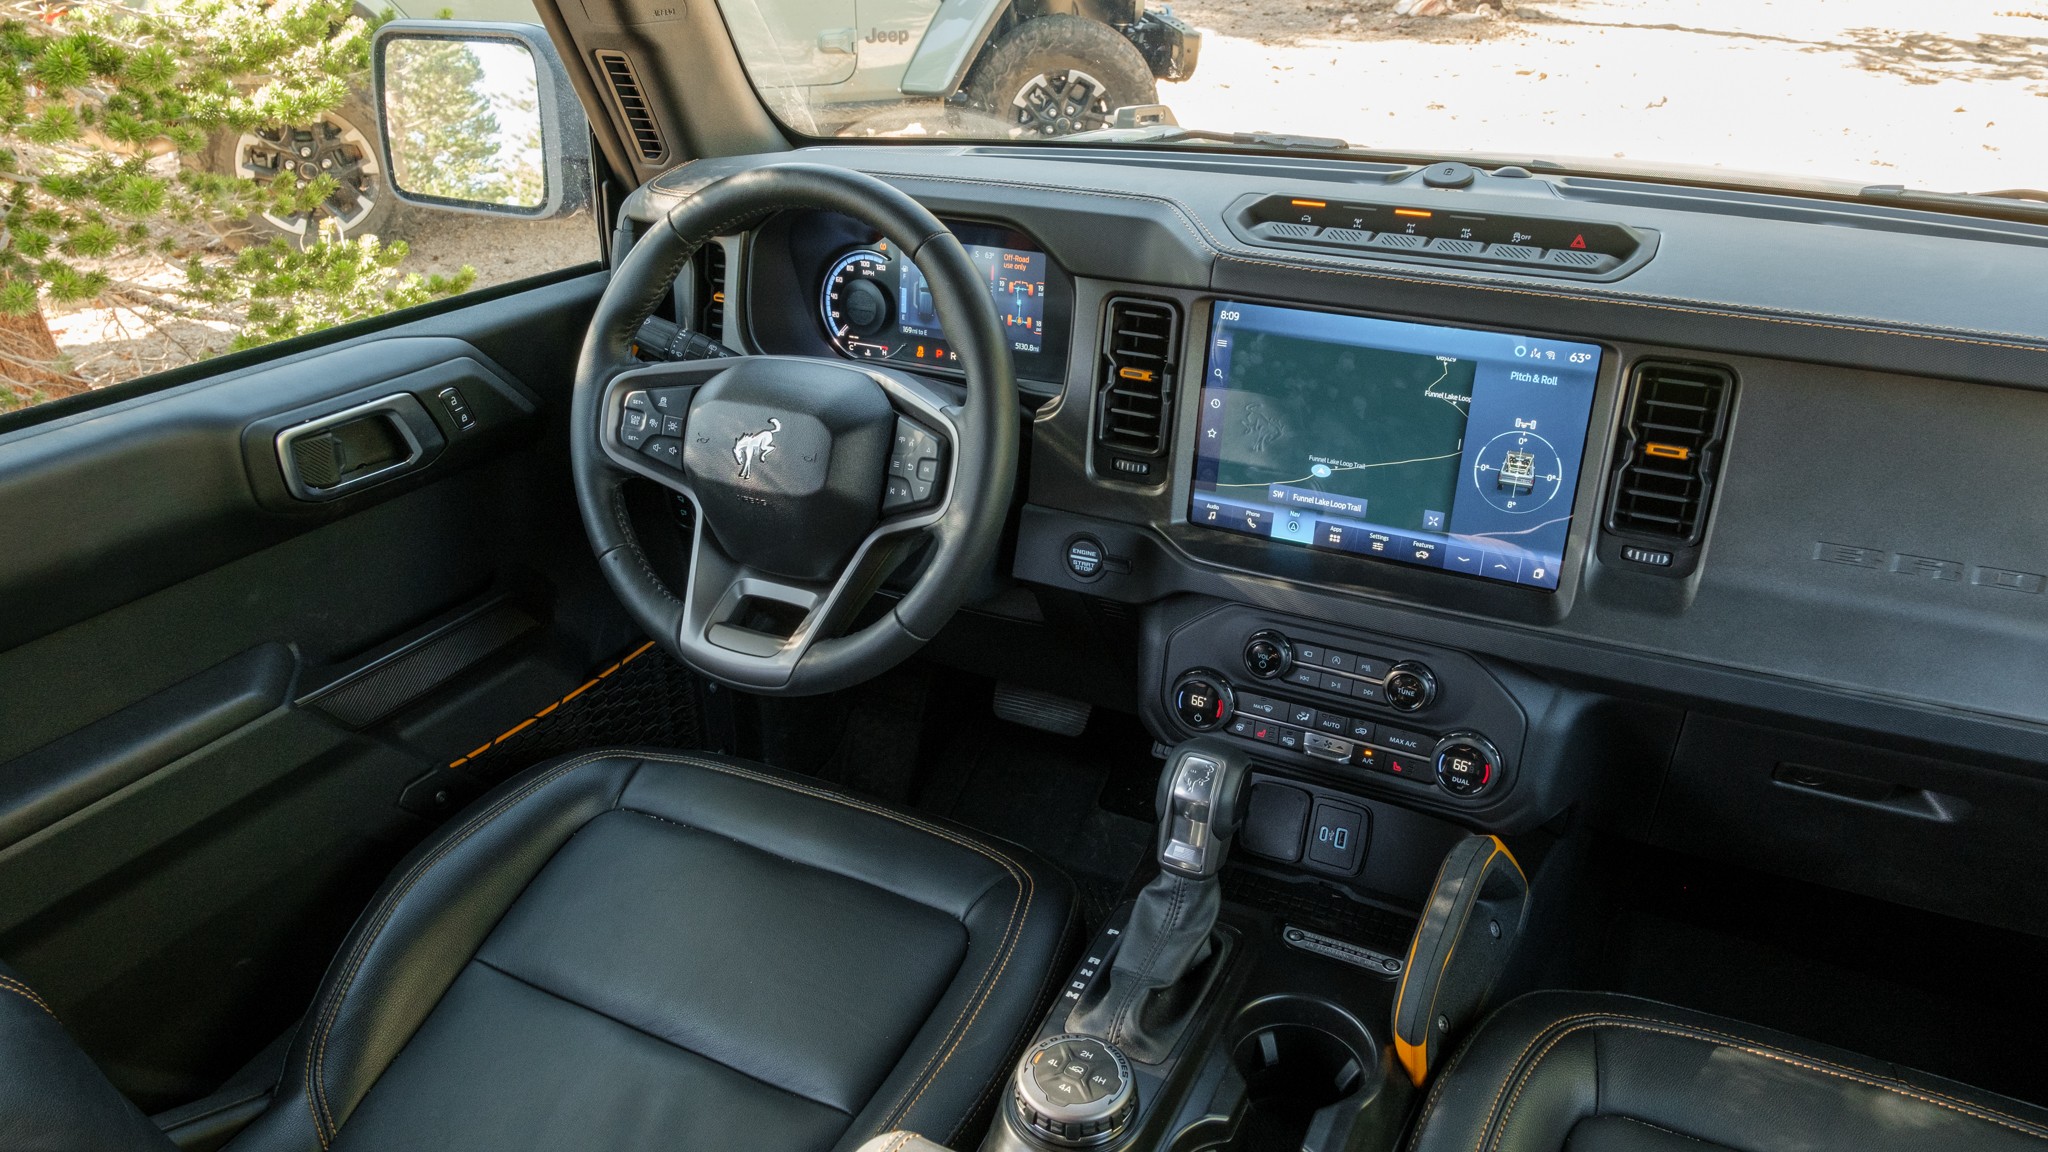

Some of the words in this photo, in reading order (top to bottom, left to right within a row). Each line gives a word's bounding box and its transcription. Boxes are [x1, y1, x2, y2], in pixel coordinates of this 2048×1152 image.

[865, 27, 910, 45] Jeep
[1003, 253, 1030, 264] Off-Road
[860, 260, 870, 268] 100
[875, 263, 886, 272] 120
[1220, 310, 1240, 321] 8:09
[935, 349, 943, 358] P
[950, 352, 957, 360] R
[1569, 352, 1592, 364] 63°
[1510, 371, 1532, 383] Pitch
[1532, 373, 1540, 383] &
[1541, 374, 1558, 386] Roll
[1425, 390, 1444, 399] Funnel
[1444, 393, 1458, 401] Lake
[1308, 454, 1326, 463] Funnel
[1327, 457, 1339, 465] Lake
[1354, 462, 1366, 470] Trail
[1272, 490, 1285, 499] SW
[1292, 493, 1314, 504] Funnel
[1314, 496, 1330, 507] Lake
[1330, 498, 1347, 510] Loop
[1347, 501, 1362, 512] Trail
[1206, 503, 1220, 511] Audio
[1245, 510, 1260, 518] Phone
[1289, 510, 1300, 518] Nav
[1329, 526, 1342, 534] Apps
[1369, 532, 1390, 542] Settings
[1412, 540, 1435, 550] Features
[1072, 548, 1097, 557] ENGINE
[1072, 560, 1095, 568] START
[1397, 687, 1415, 697] TUNE
[1323, 720, 1340, 729] AUTO
[1389, 736, 1404, 745] MAX
[1405, 739, 1417, 748] A/C
[1362, 757, 1374, 765] A/C
[1451, 776, 1470, 786] DUAL
[1080, 968, 1094, 977] N
[1065, 990, 1080, 1000] M
[1080, 1050, 1094, 1059] 2H
[1047, 1058, 1059, 1067] 4L
[1107, 1045, 1129, 1079] MODES
[1092, 1075, 1107, 1085] 4H
[1058, 1083, 1072, 1094] 4A
